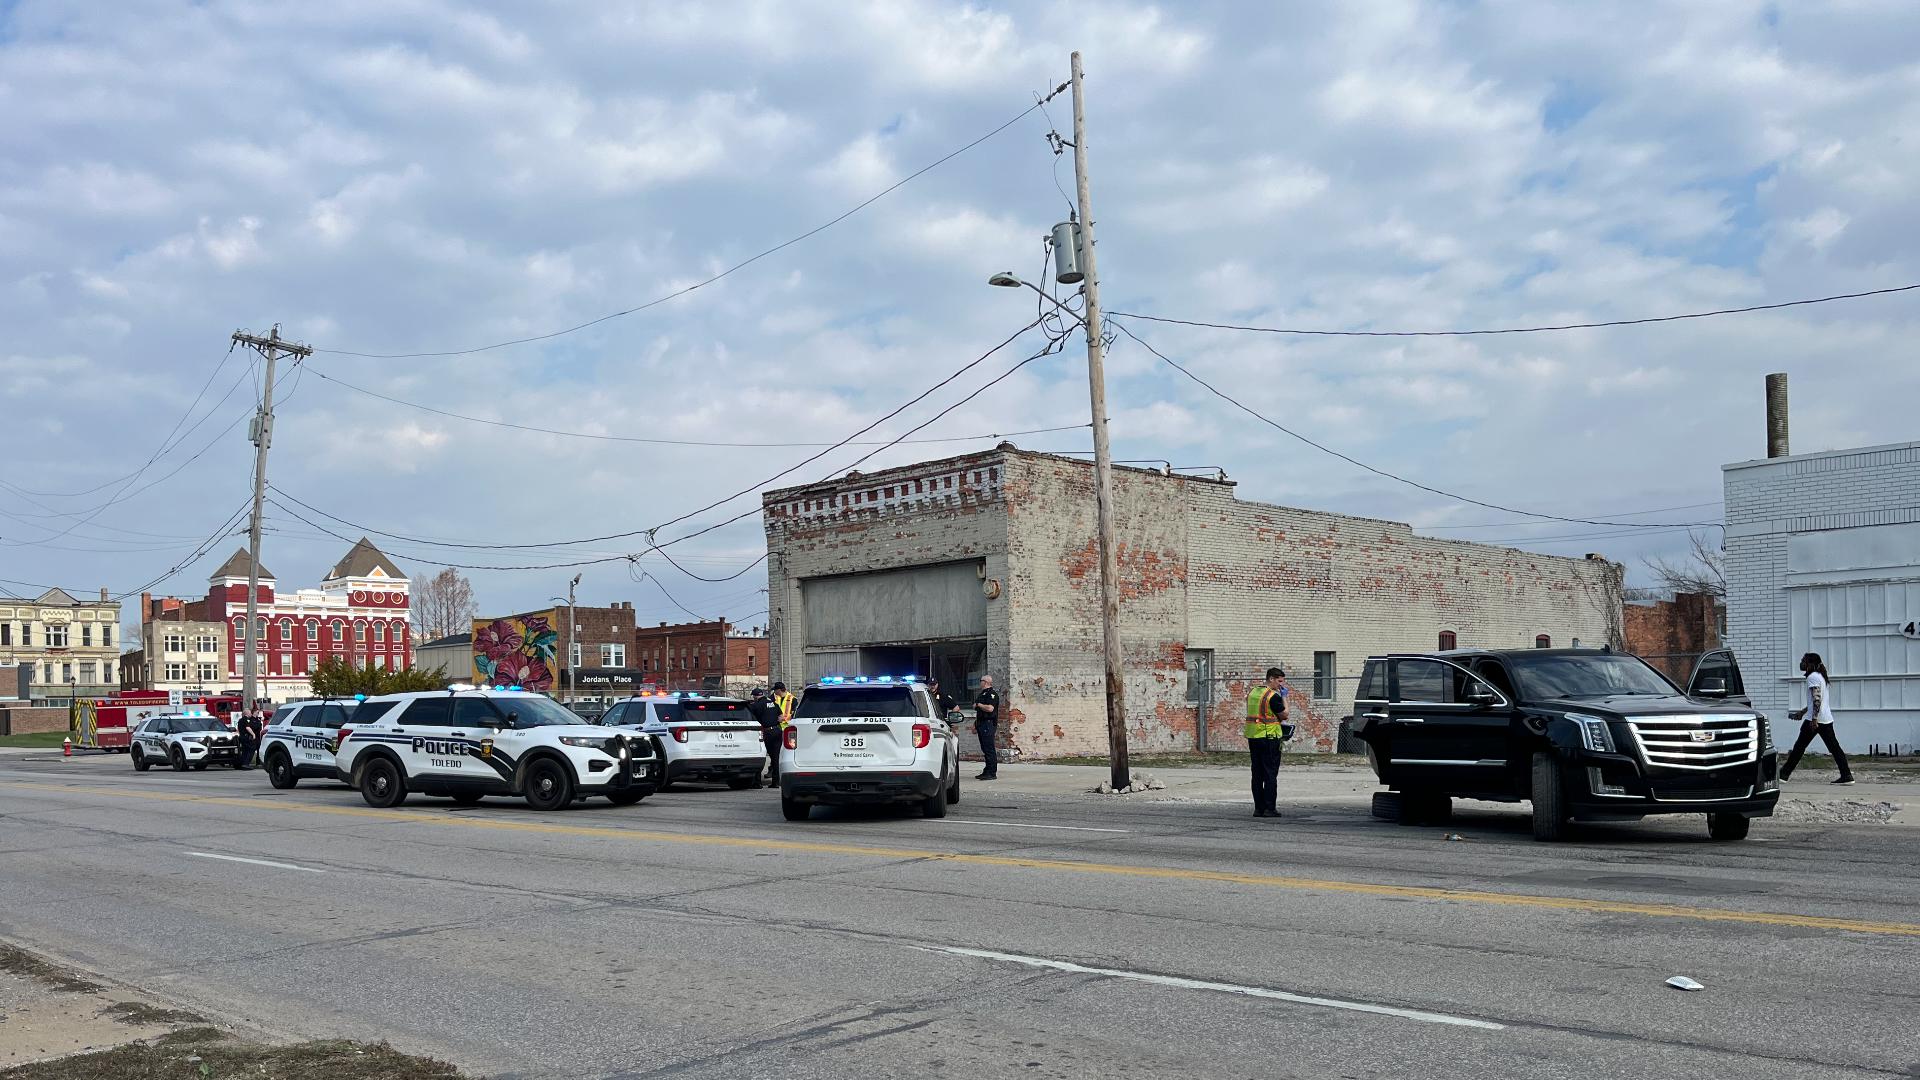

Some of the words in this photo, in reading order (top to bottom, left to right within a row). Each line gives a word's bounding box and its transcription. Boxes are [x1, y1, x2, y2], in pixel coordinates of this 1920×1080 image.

[582, 675, 610, 683] Jordans
[613, 675, 632, 683] Place
[295, 735, 326, 750] POLICE
[412, 737, 470, 756] POLICE
[843, 738, 864, 747] 385
[431, 759, 462, 768] TOLEDO
